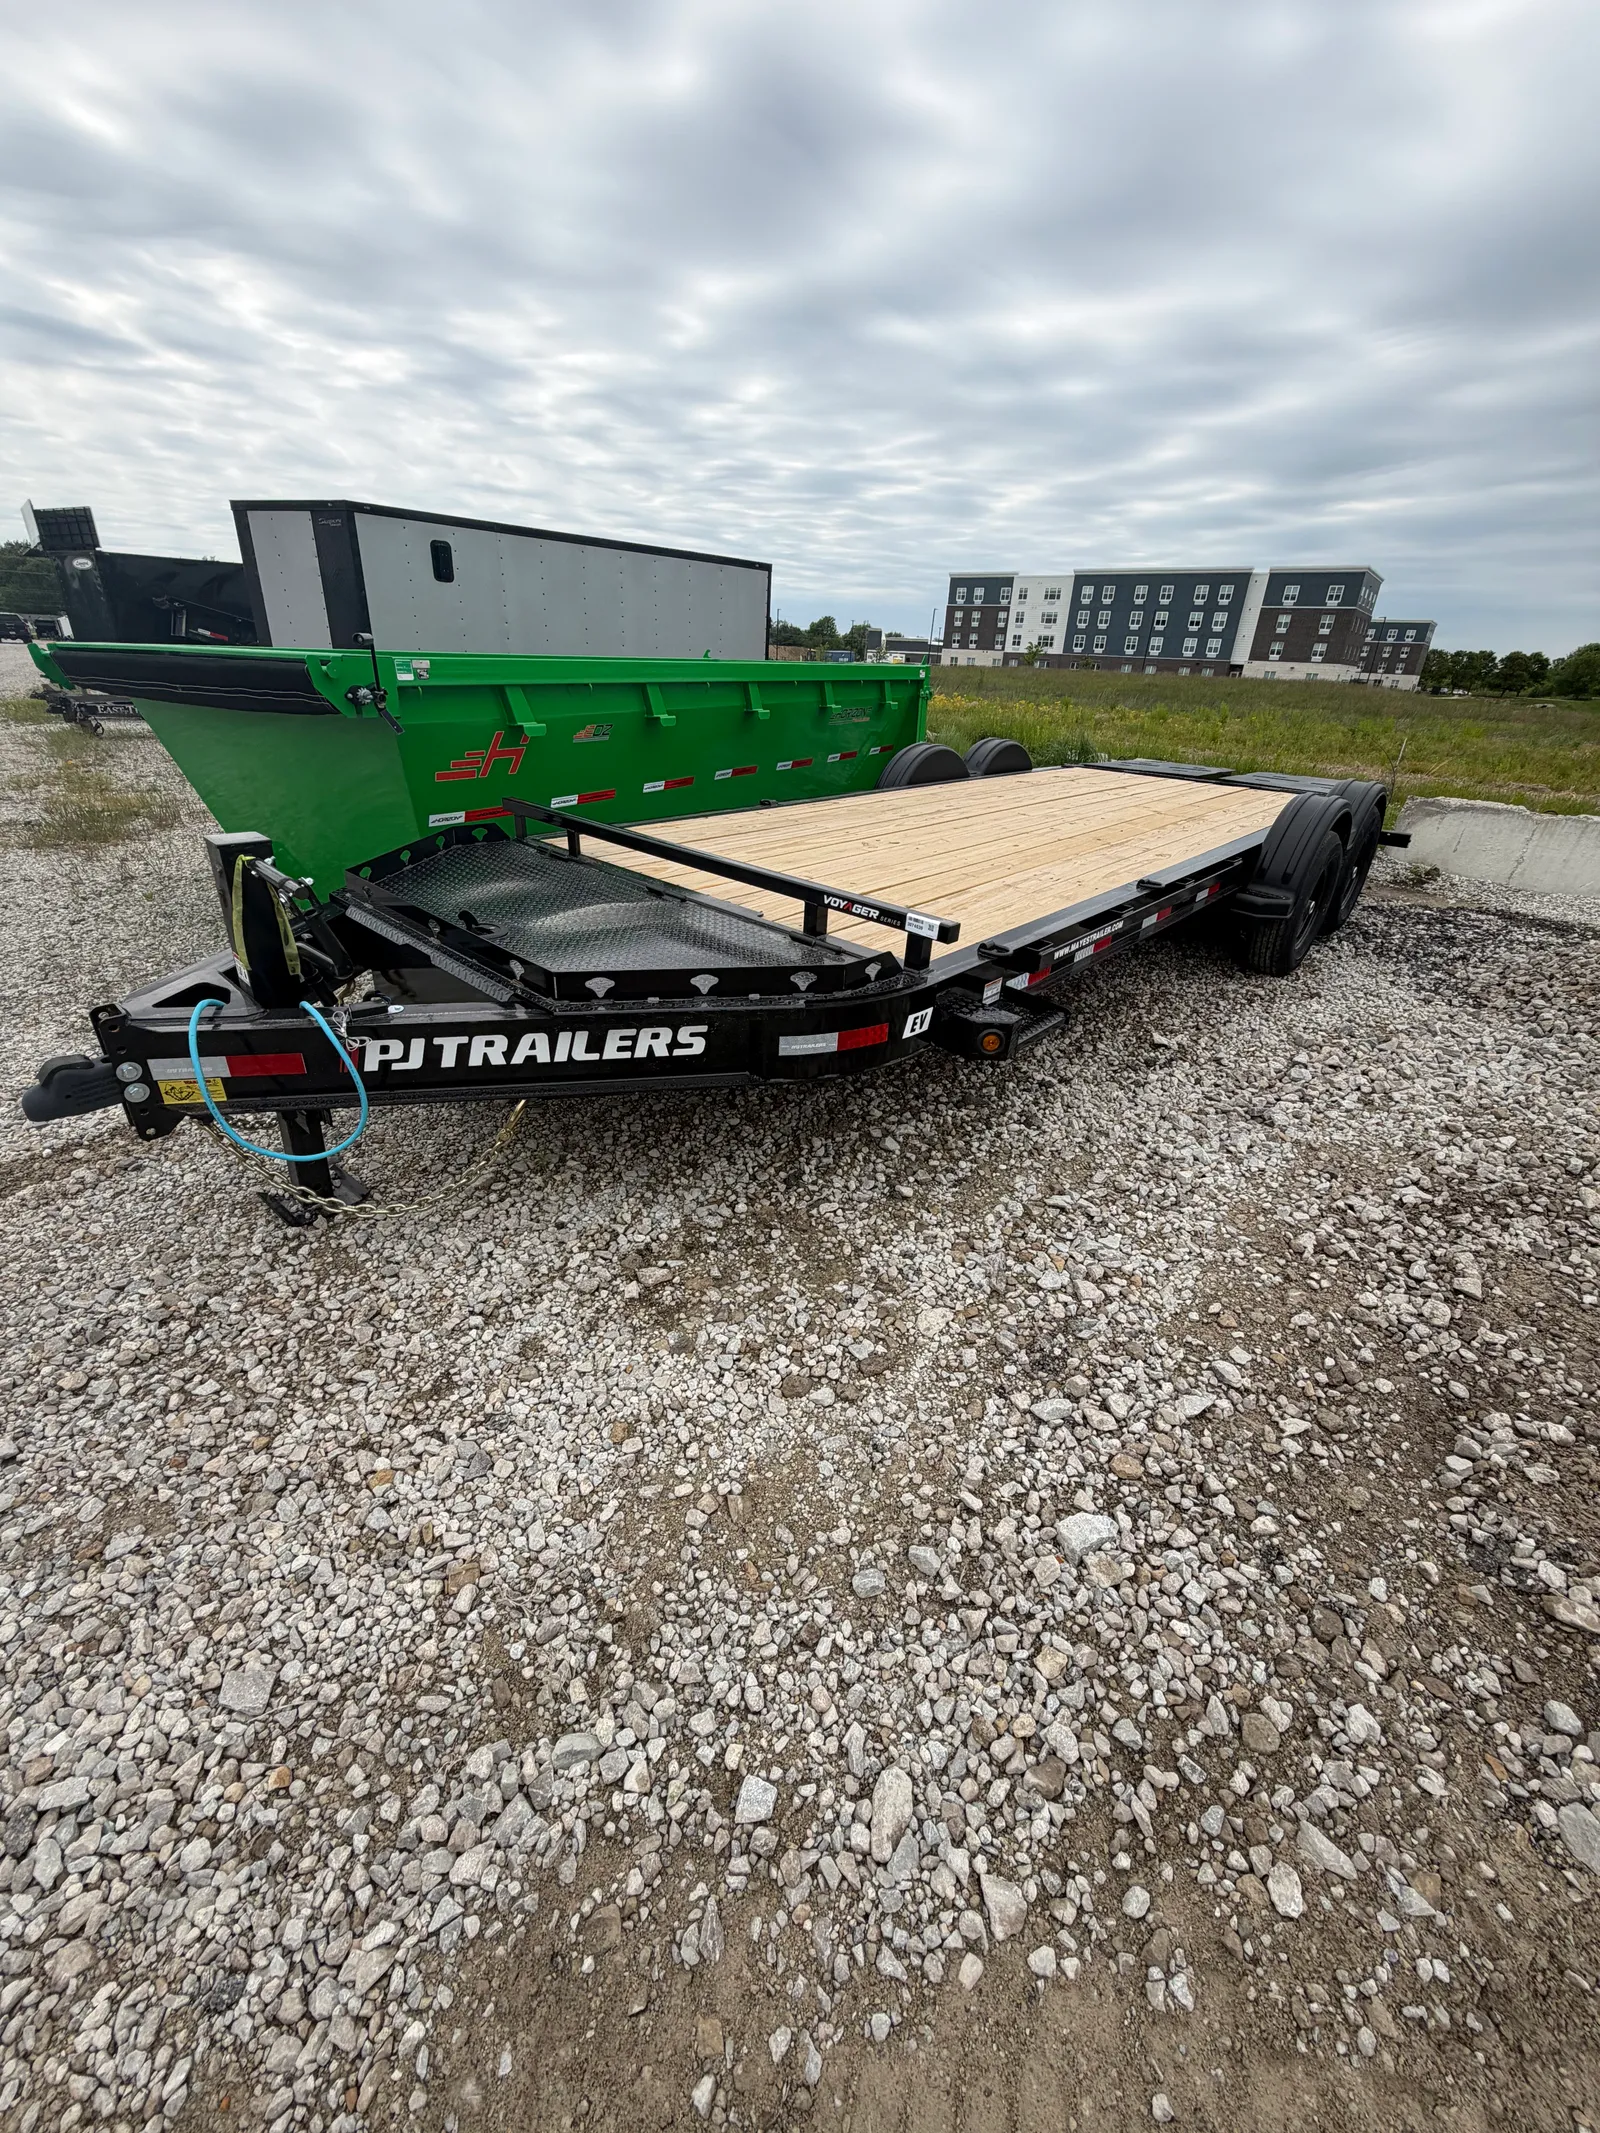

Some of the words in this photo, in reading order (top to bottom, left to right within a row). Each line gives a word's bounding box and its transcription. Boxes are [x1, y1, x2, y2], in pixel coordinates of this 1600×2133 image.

[823, 894, 880, 919] VOYAGER
[880, 916, 901, 927] SERIES
[1054, 920, 1124, 960] WWW.MAYESTRAILER.COM
[909, 1011, 929, 1034] EV
